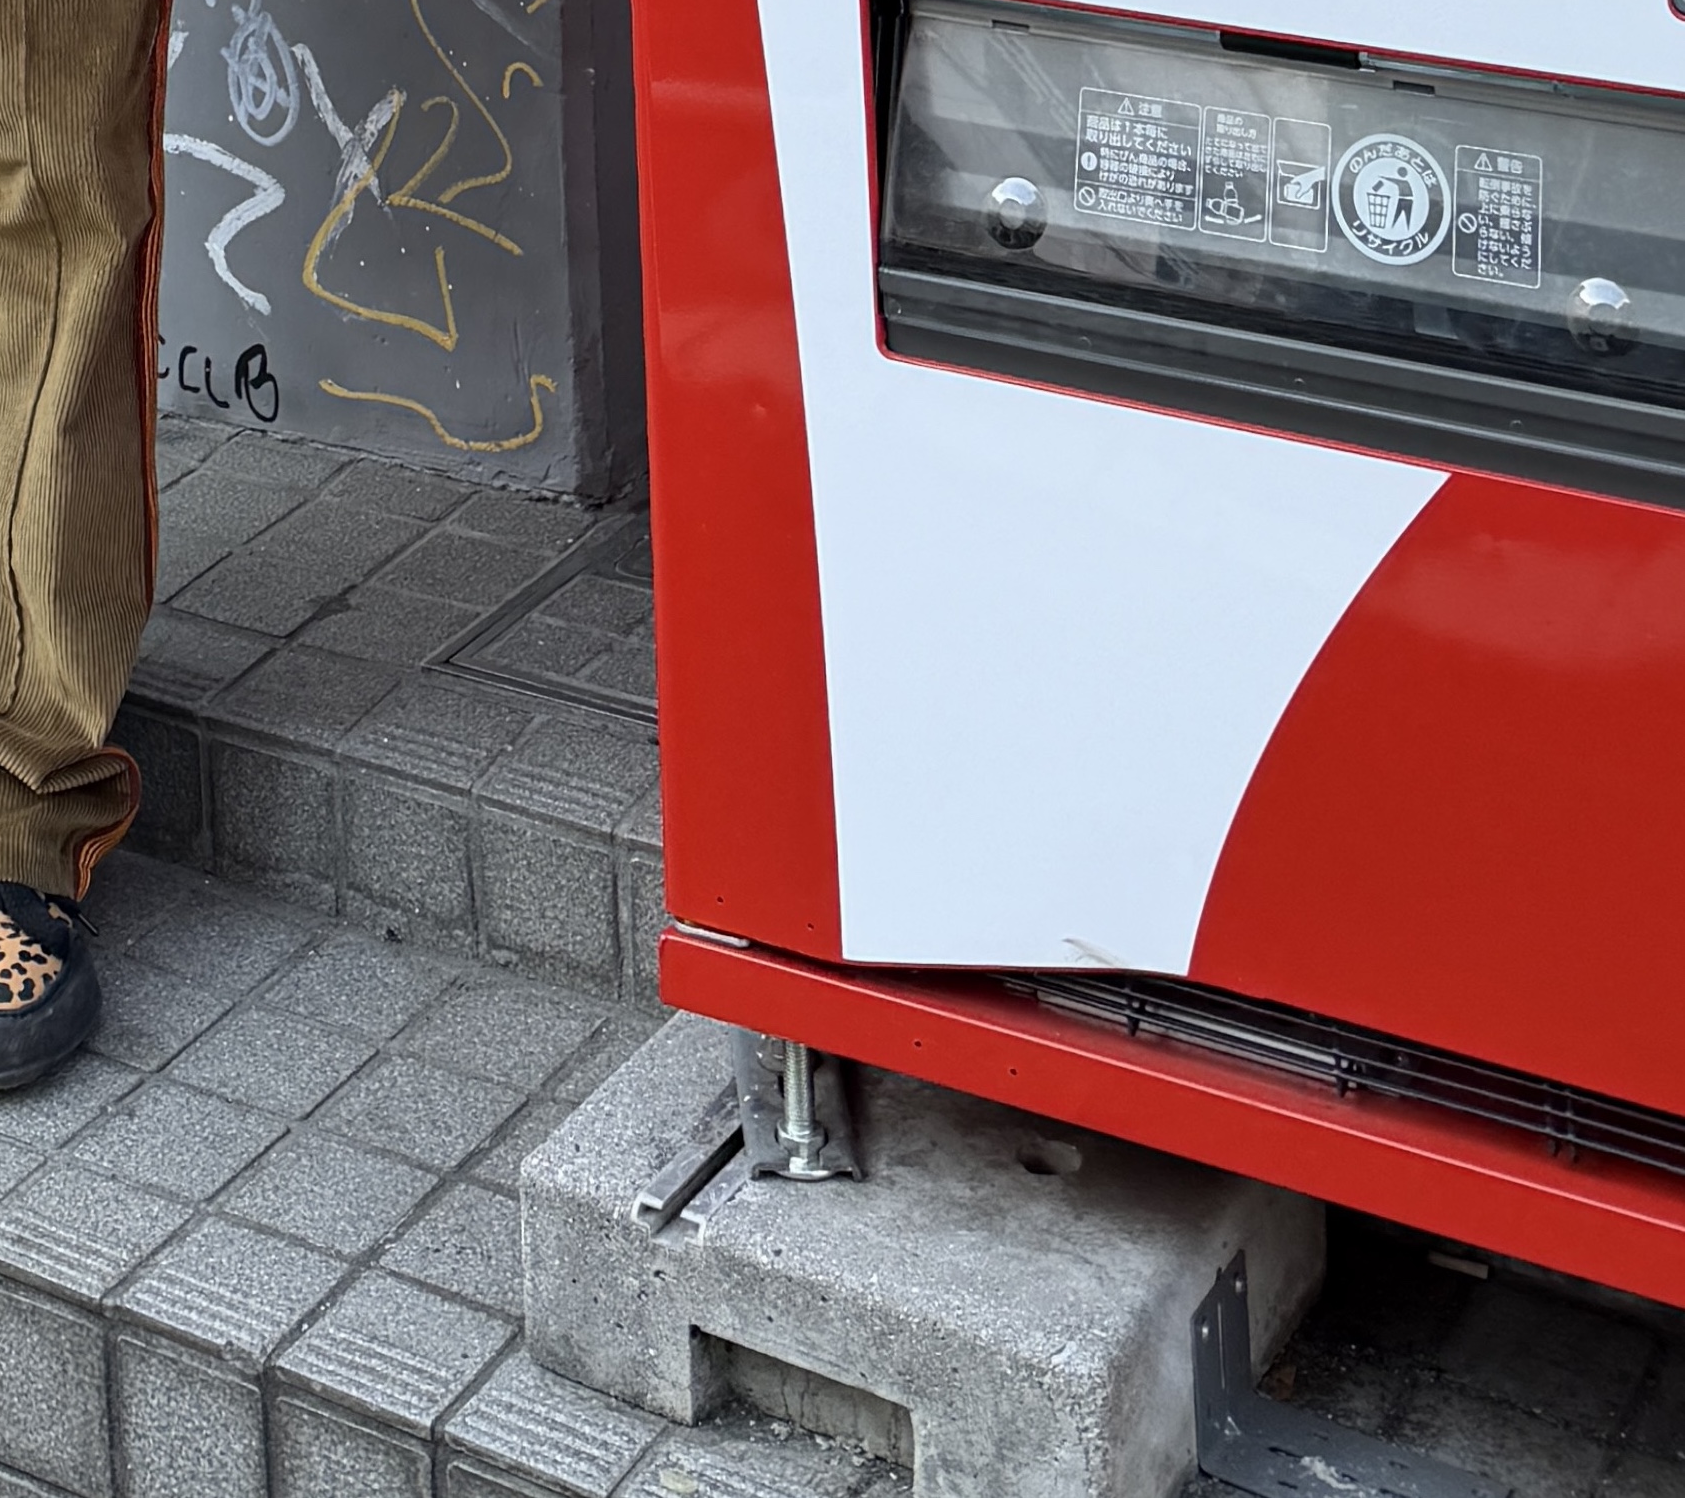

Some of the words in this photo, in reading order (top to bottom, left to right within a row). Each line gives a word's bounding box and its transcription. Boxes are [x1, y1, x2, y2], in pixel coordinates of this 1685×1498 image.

[1349, 143, 1437, 188] のんだあとは
[1352, 220, 1429, 255] リサイクル
